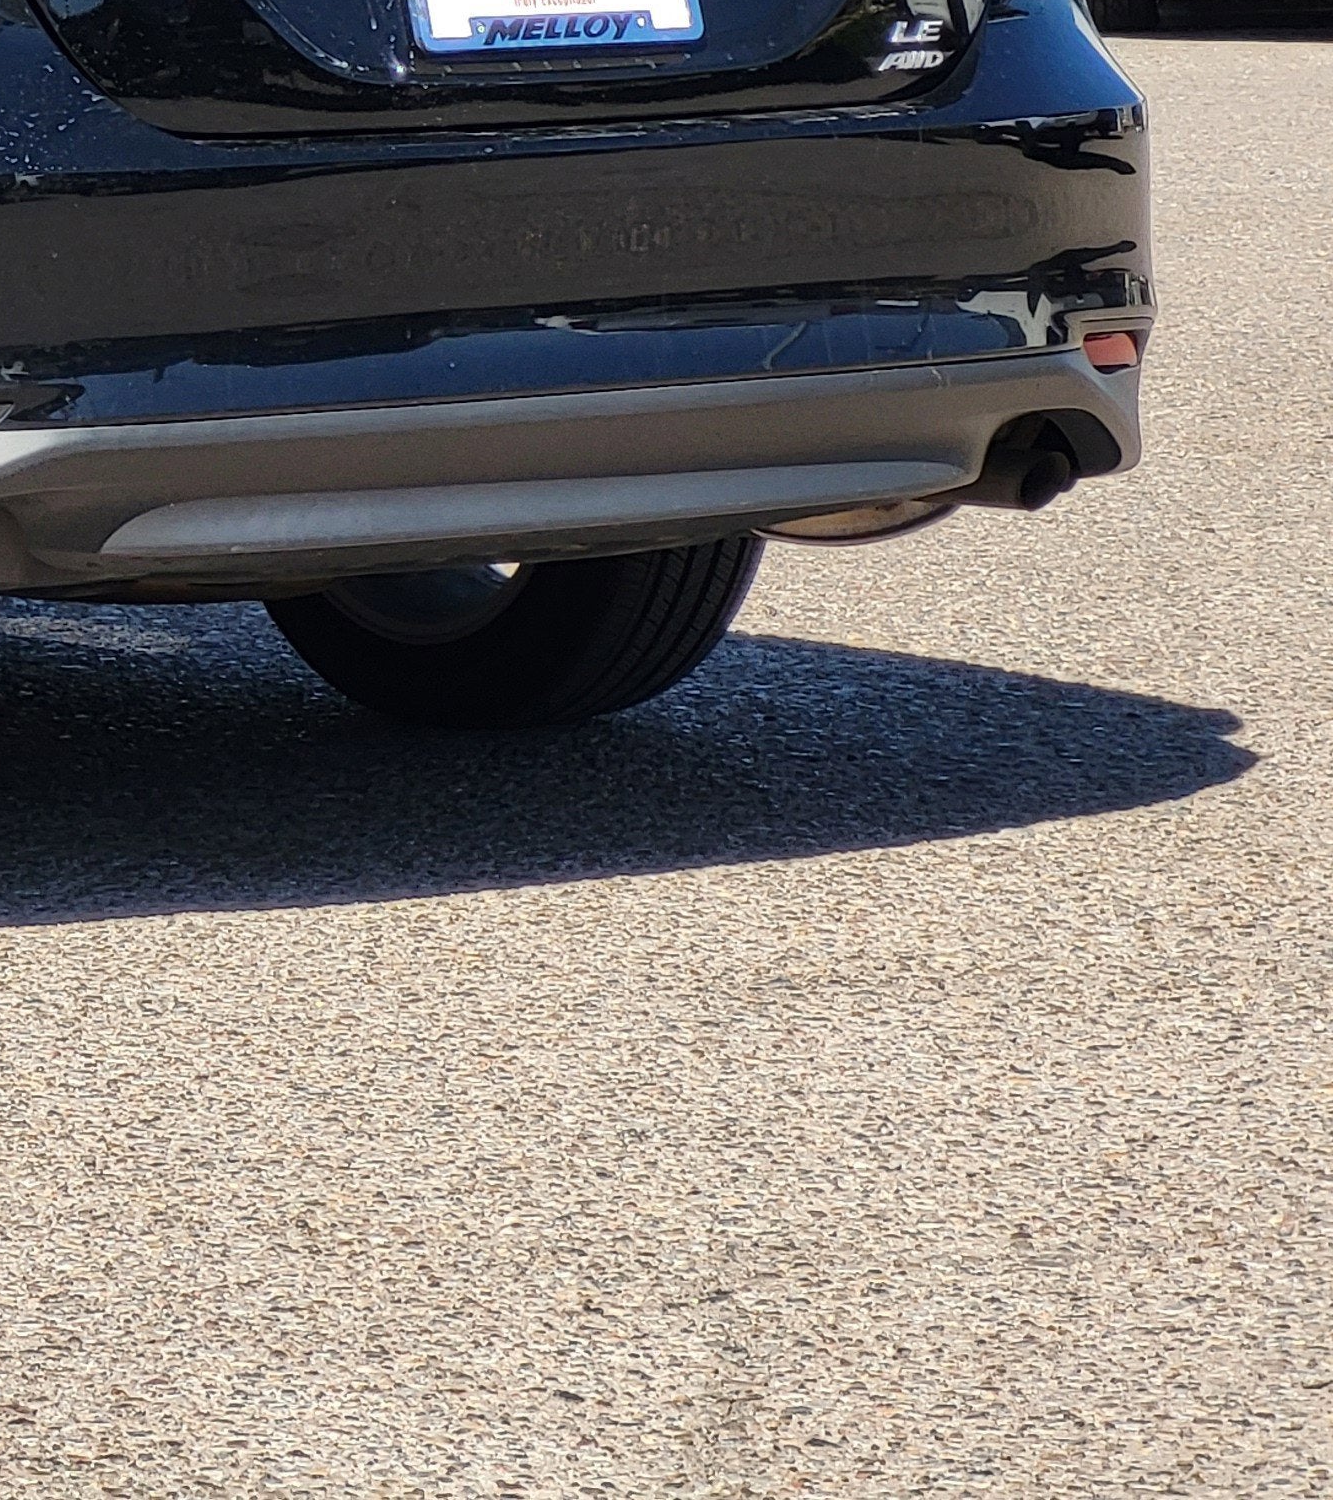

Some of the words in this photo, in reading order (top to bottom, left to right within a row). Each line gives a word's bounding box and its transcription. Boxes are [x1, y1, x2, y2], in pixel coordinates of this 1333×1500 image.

[483, 13, 632, 45] MELLOY
[889, 19, 944, 43] LE
[878, 50, 945, 71] AWD
